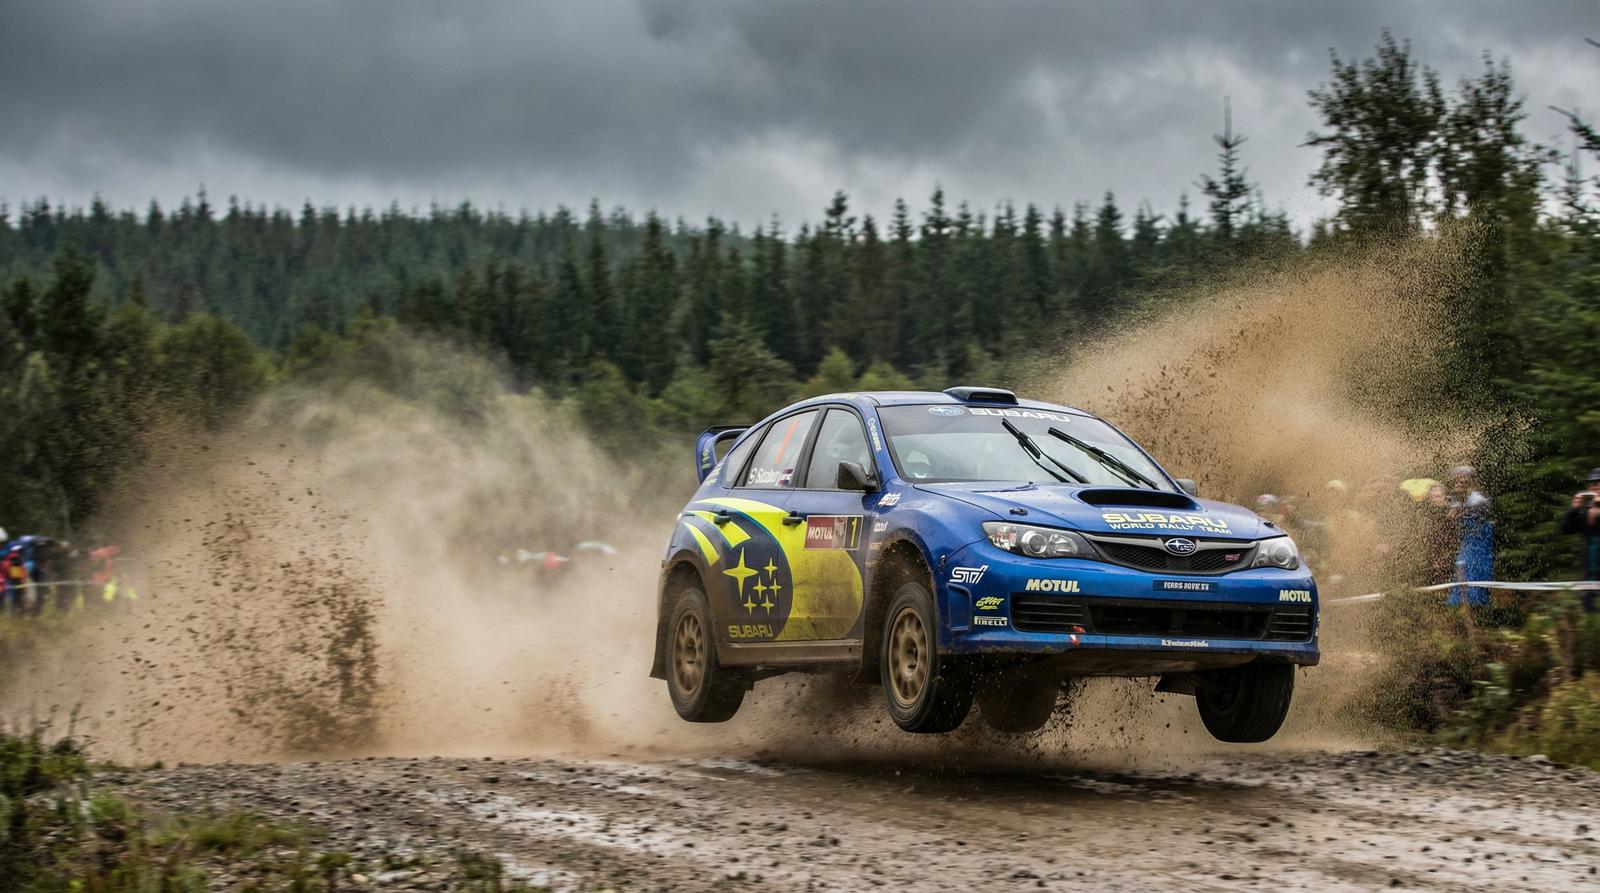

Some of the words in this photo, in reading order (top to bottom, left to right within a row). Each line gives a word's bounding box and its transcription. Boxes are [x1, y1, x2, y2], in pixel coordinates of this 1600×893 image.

[968, 408, 1071, 422] SUBARU
[1102, 513, 1228, 529] SUBARU
[807, 526, 833, 540] MOTUL
[850, 518, 858, 547] 1
[1158, 523, 1194, 531] RALLY
[1199, 525, 1232, 534] TEAM
[1025, 578, 1080, 593] MOTUL
[1279, 589, 1311, 602] MOTUL
[974, 615, 1008, 626] PIRELLI
[728, 624, 773, 638] SUBARU
